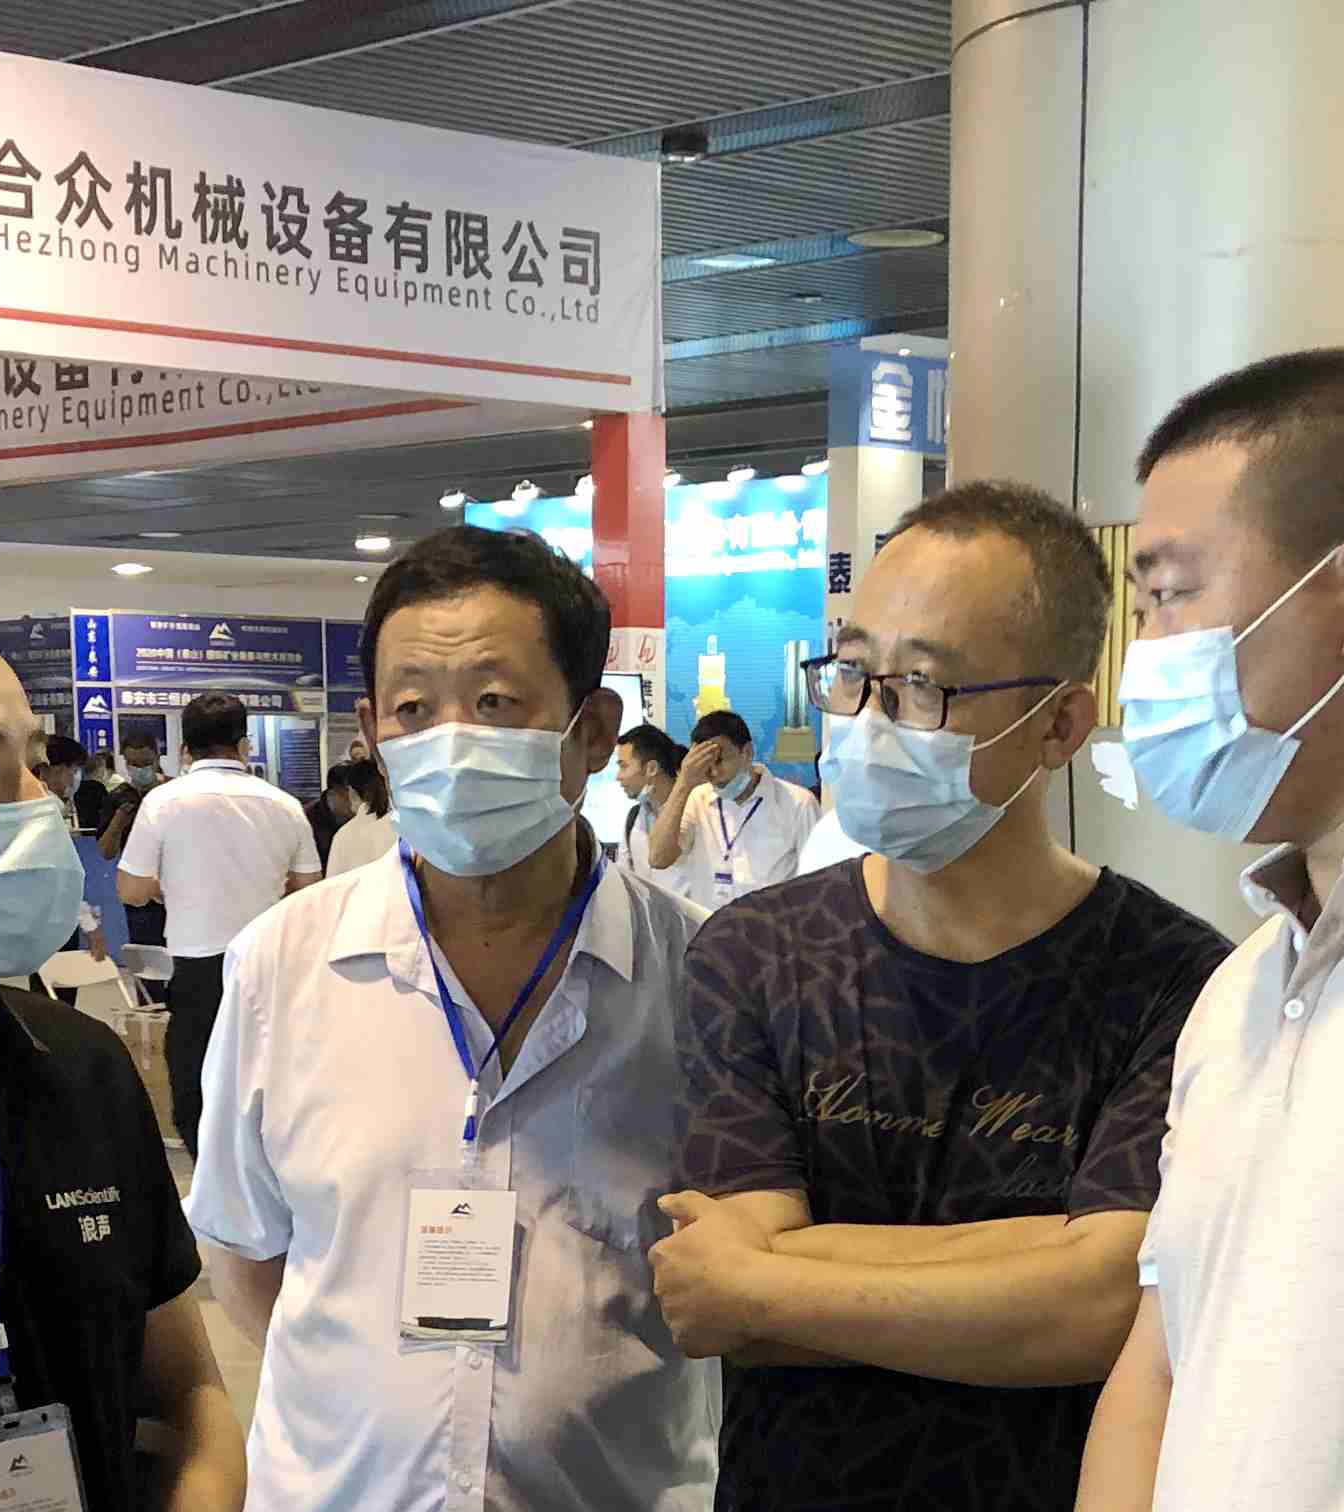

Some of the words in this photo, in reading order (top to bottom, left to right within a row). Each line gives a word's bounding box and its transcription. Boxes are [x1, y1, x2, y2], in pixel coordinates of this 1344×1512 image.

[158, 242, 322, 296] Machinery
[336, 266, 493, 312] Equipment
[61, 377, 206, 426] Equipment
[77, 1213, 112, 1243] 浪声
